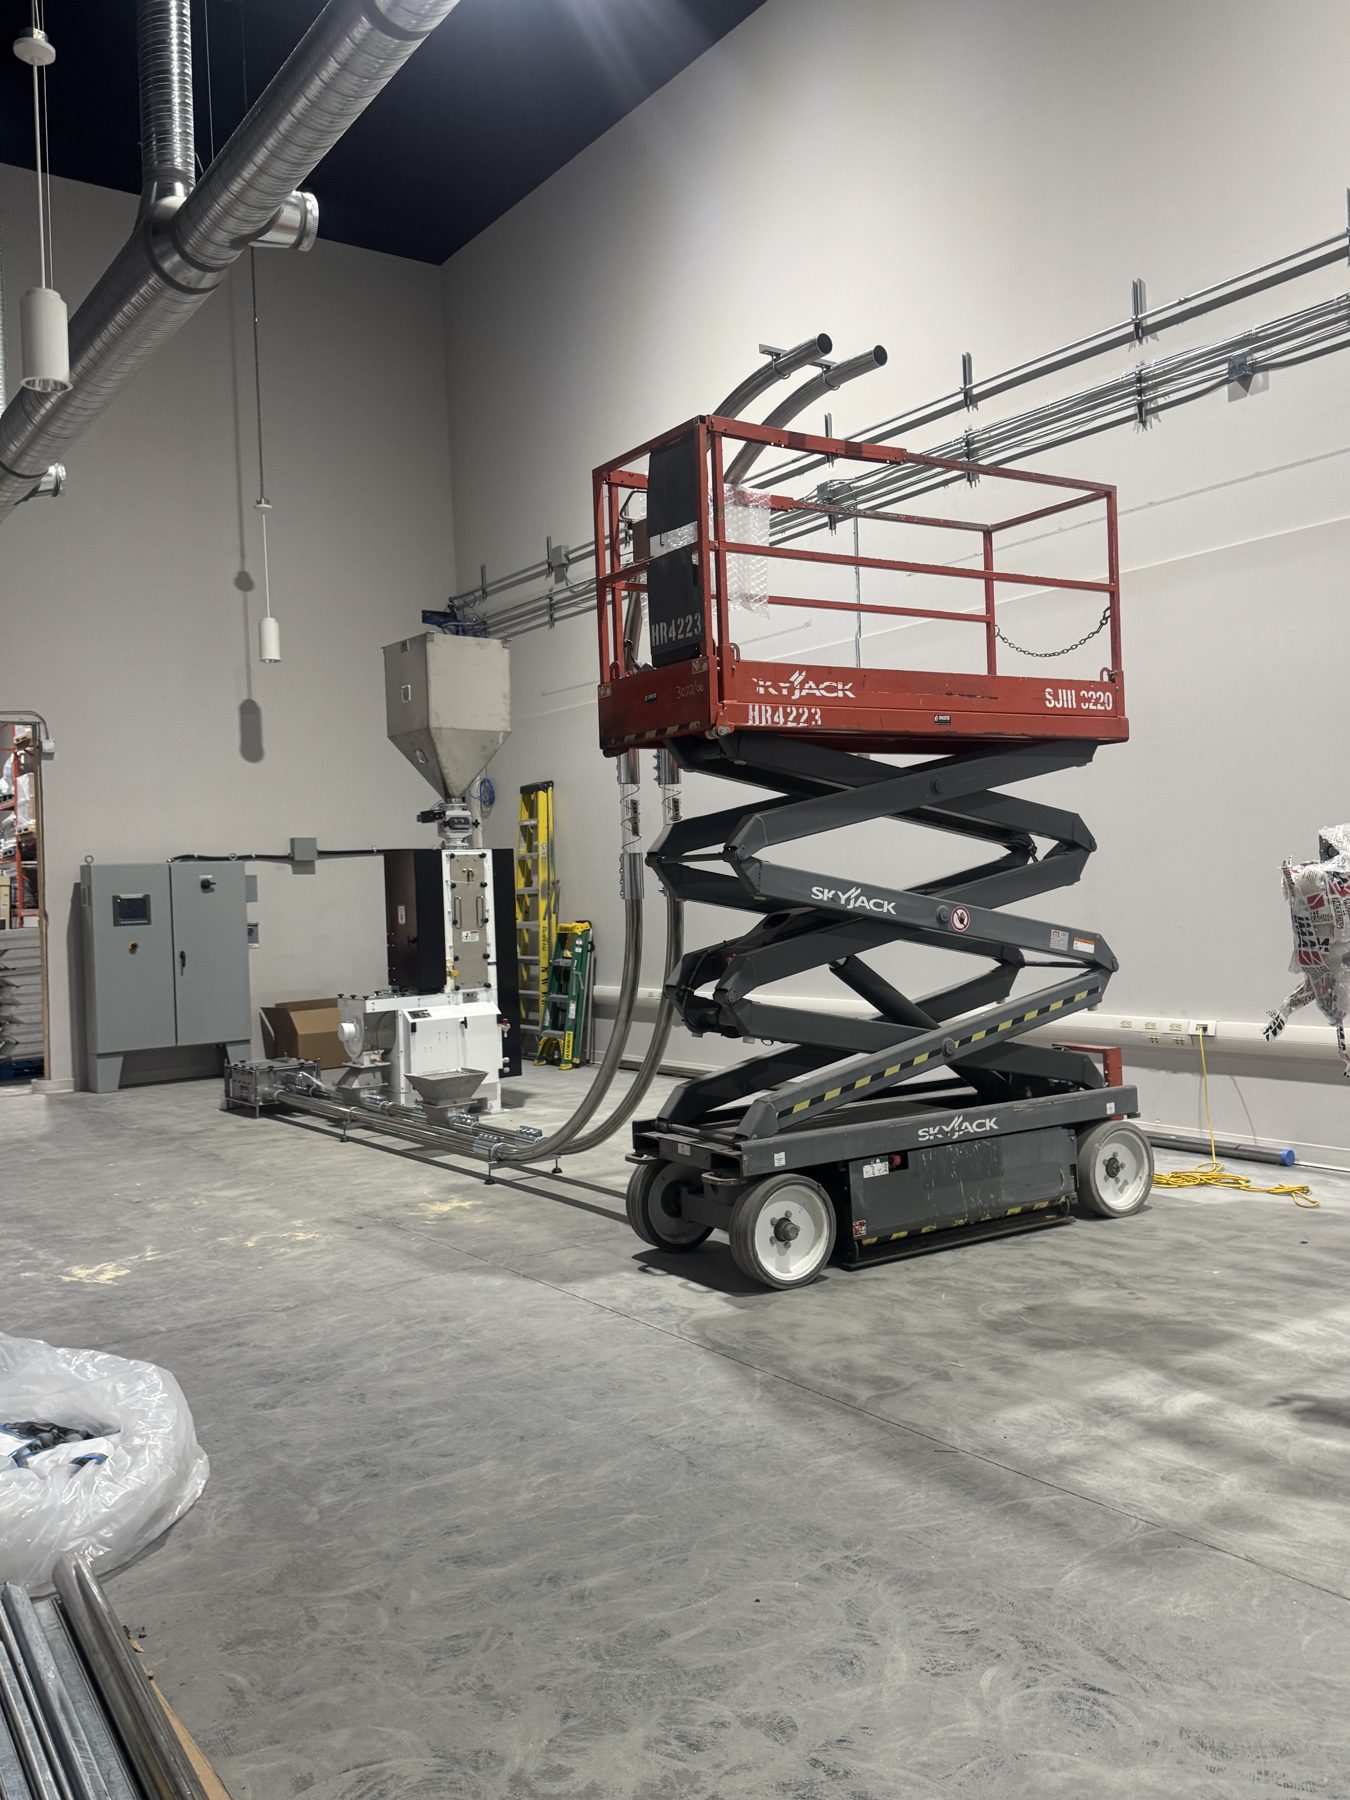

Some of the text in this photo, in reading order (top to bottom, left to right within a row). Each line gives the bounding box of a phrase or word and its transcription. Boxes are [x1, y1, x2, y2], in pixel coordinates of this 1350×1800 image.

[651, 612, 702, 646] HR4223
[752, 670, 856, 699] KYJACK
[1044, 687, 1077, 708] SJIII
[746, 703, 822, 727] HR4223
[811, 886, 897, 915] SKYJACK
[917, 1115, 999, 1141] SKYJACK
